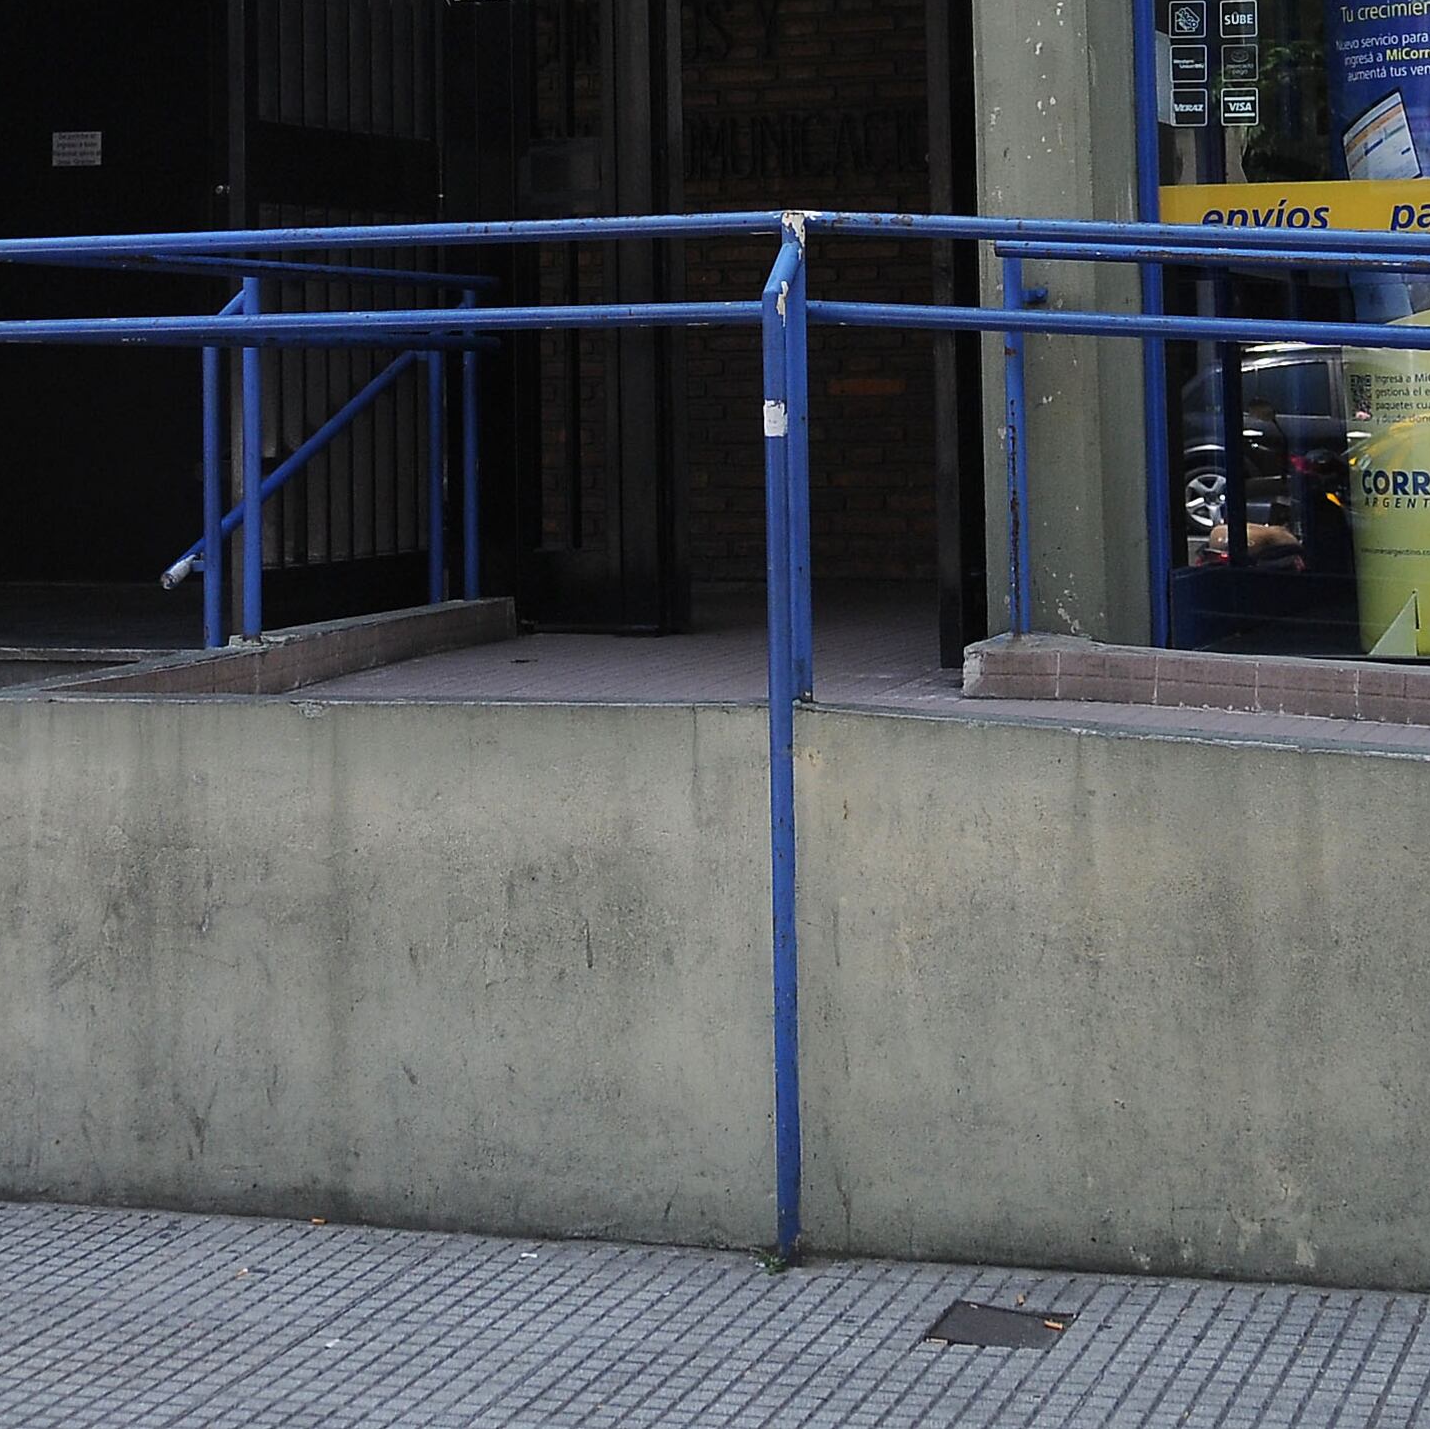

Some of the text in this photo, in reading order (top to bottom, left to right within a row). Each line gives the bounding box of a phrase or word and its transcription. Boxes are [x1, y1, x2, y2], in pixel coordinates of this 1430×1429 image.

[1340, 6, 1354, 23] Tu
[1361, 32, 1399, 48] servicio
[1402, 32, 1429, 46] para
[1376, 53, 1383, 63] a
[1347, 66, 1387, 82] aumentá
[1390, 66, 1407, 78] tus
[1227, 102, 1253, 111] VISA
[1202, 198, 1330, 229] envíos
[1413, 386, 1422, 396] el
